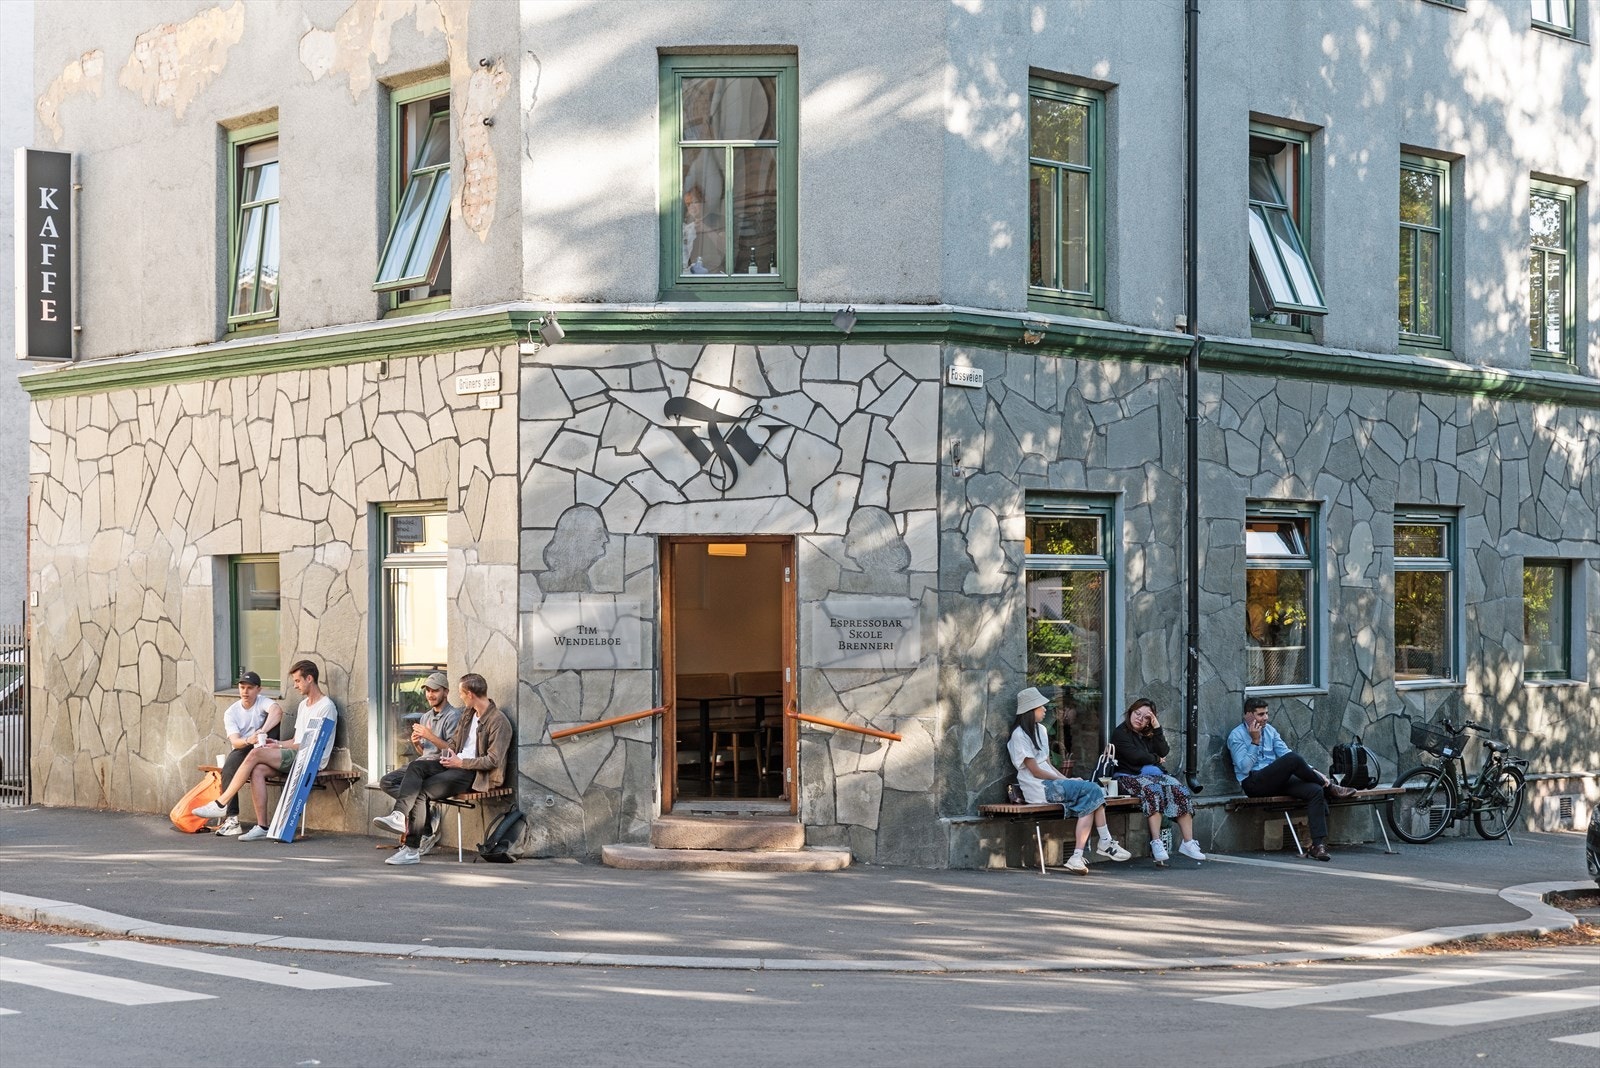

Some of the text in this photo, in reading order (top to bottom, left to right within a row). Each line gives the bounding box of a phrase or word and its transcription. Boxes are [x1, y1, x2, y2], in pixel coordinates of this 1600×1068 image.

[39, 187, 59, 321] KAFFE
[484, 377, 496, 390] gate
[951, 368, 983, 384] Fossveien
